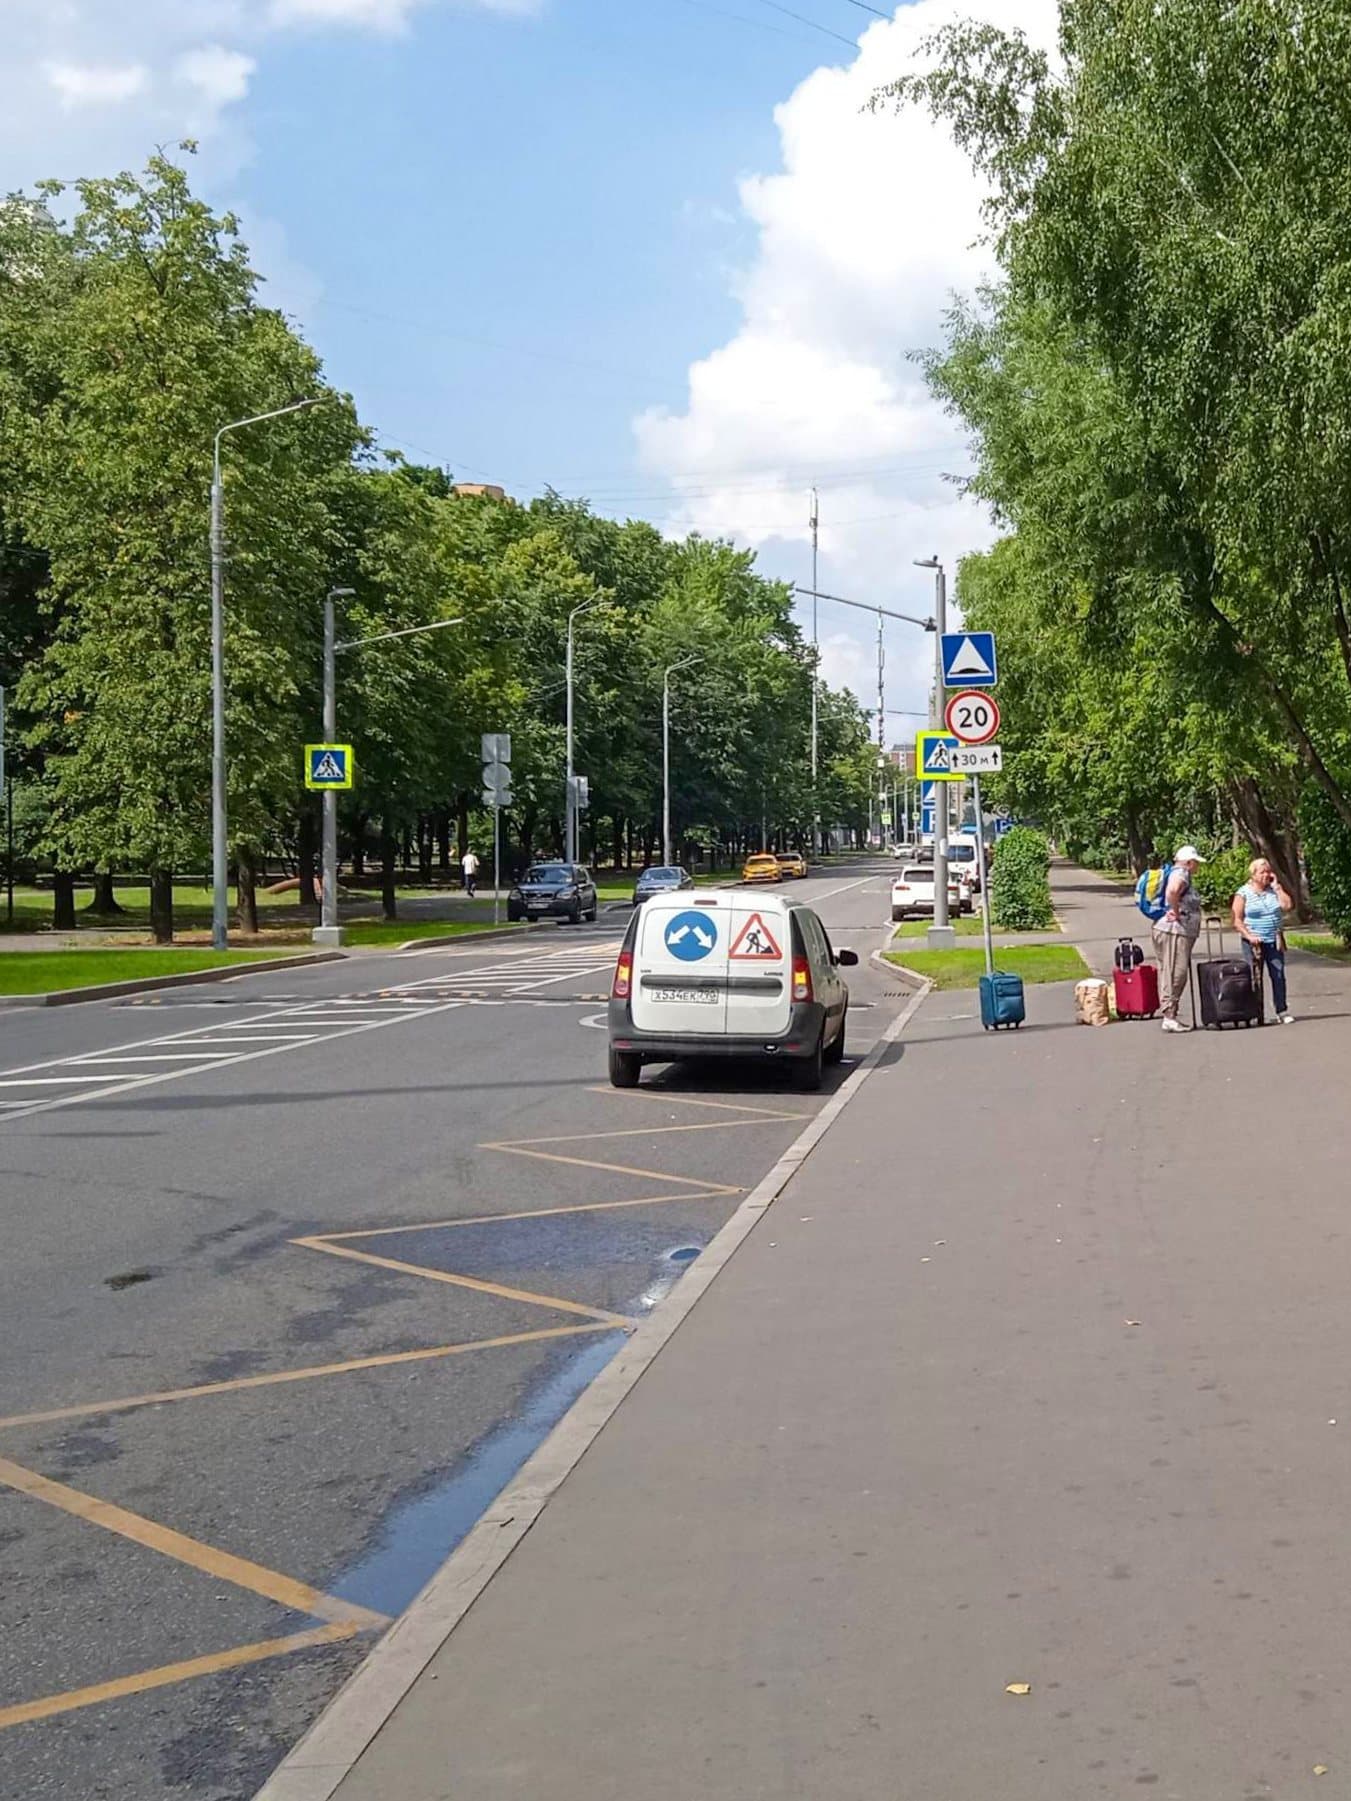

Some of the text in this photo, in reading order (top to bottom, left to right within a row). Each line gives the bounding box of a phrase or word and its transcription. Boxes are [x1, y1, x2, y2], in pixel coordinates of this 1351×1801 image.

[958, 706, 988, 728] 20
[961, 754, 989, 766] 30 м
